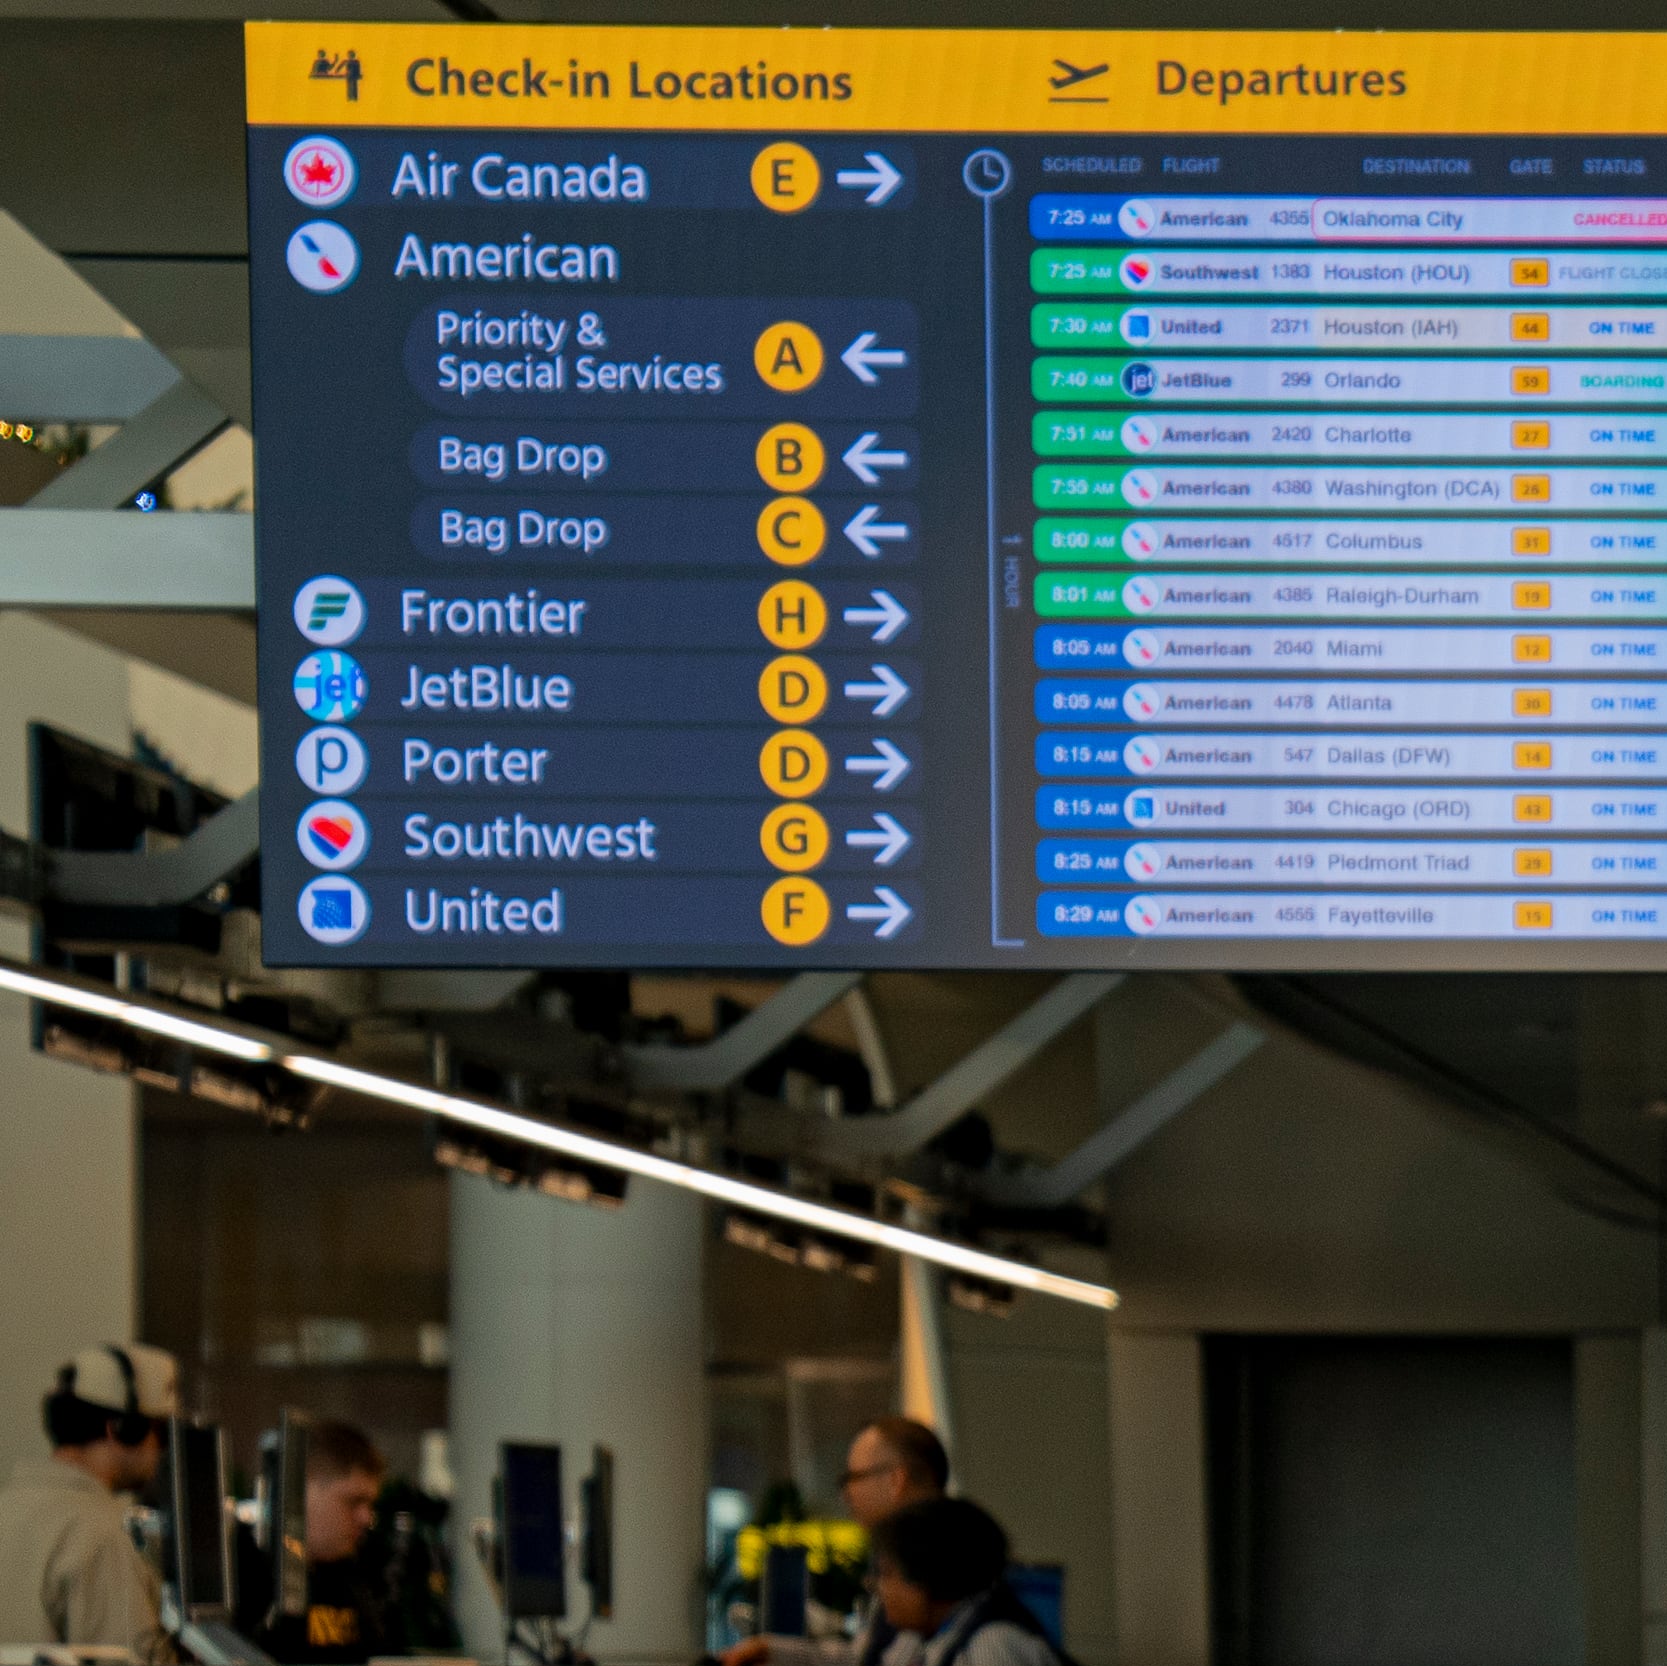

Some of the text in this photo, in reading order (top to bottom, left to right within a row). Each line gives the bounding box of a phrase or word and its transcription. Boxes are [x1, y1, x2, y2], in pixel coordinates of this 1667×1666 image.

[407, 58, 852, 100] Check-in Locations
[1158, 60, 1406, 104] Departures
[392, 152, 795, 200] Air Canada E
[1163, 158, 1220, 174] FLIGHT
[1364, 158, 1470, 174] DESTINATION
[1510, 158, 1552, 174] GATE
[1583, 158, 1644, 174] STATUS
[1160, 211, 1248, 227] American
[1324, 210, 1421, 228] Oklahoma
[1427, 210, 1464, 230] City
[394, 234, 617, 280] American
[1161, 264, 1259, 280] Southwest
[1324, 265, 1404, 281] Houston
[1412, 264, 1471, 284] (HOU)
[1558, 266, 1615, 280] FLIGHT
[438, 312, 606, 352] Priority &
[1162, 320, 1222, 335] United
[1324, 319, 1404, 336] Houston
[1411, 319, 1459, 338] (IAH)
[1589, 322, 1613, 335] ON
[1619, 322, 1654, 335] TIME
[438, 338, 803, 396] Special Services A
[1163, 372, 1232, 388] JetBlue
[1324, 372, 1401, 389] Orlando
[1581, 374, 1665, 389] BOARDING
[1162, 426, 1250, 443] American
[1325, 426, 1412, 444] Charlotte
[1590, 429, 1614, 442] ON
[1620, 429, 1655, 443] TIME
[440, 438, 802, 479] Bag Drop B
[1326, 480, 1438, 500] Washington
[442, 511, 800, 552] Bag Drop C
[1326, 532, 1422, 550] Columbus
[1327, 586, 1479, 608] Raleigh-Durham
[402, 590, 805, 634] Frontier H
[1328, 640, 1382, 657] Miami
[401, 666, 809, 710] JetBlue D
[1328, 694, 1392, 711] Atlanta
[404, 740, 810, 782] Porter D
[1328, 747, 1386, 764] Dallas
[1328, 800, 1406, 821] Chicago
[406, 814, 808, 858] Southwest G
[1328, 854, 1470, 871] Piedmont Triad
[406, 888, 804, 932] United F
[1328, 906, 1434, 927] Fayetteville
